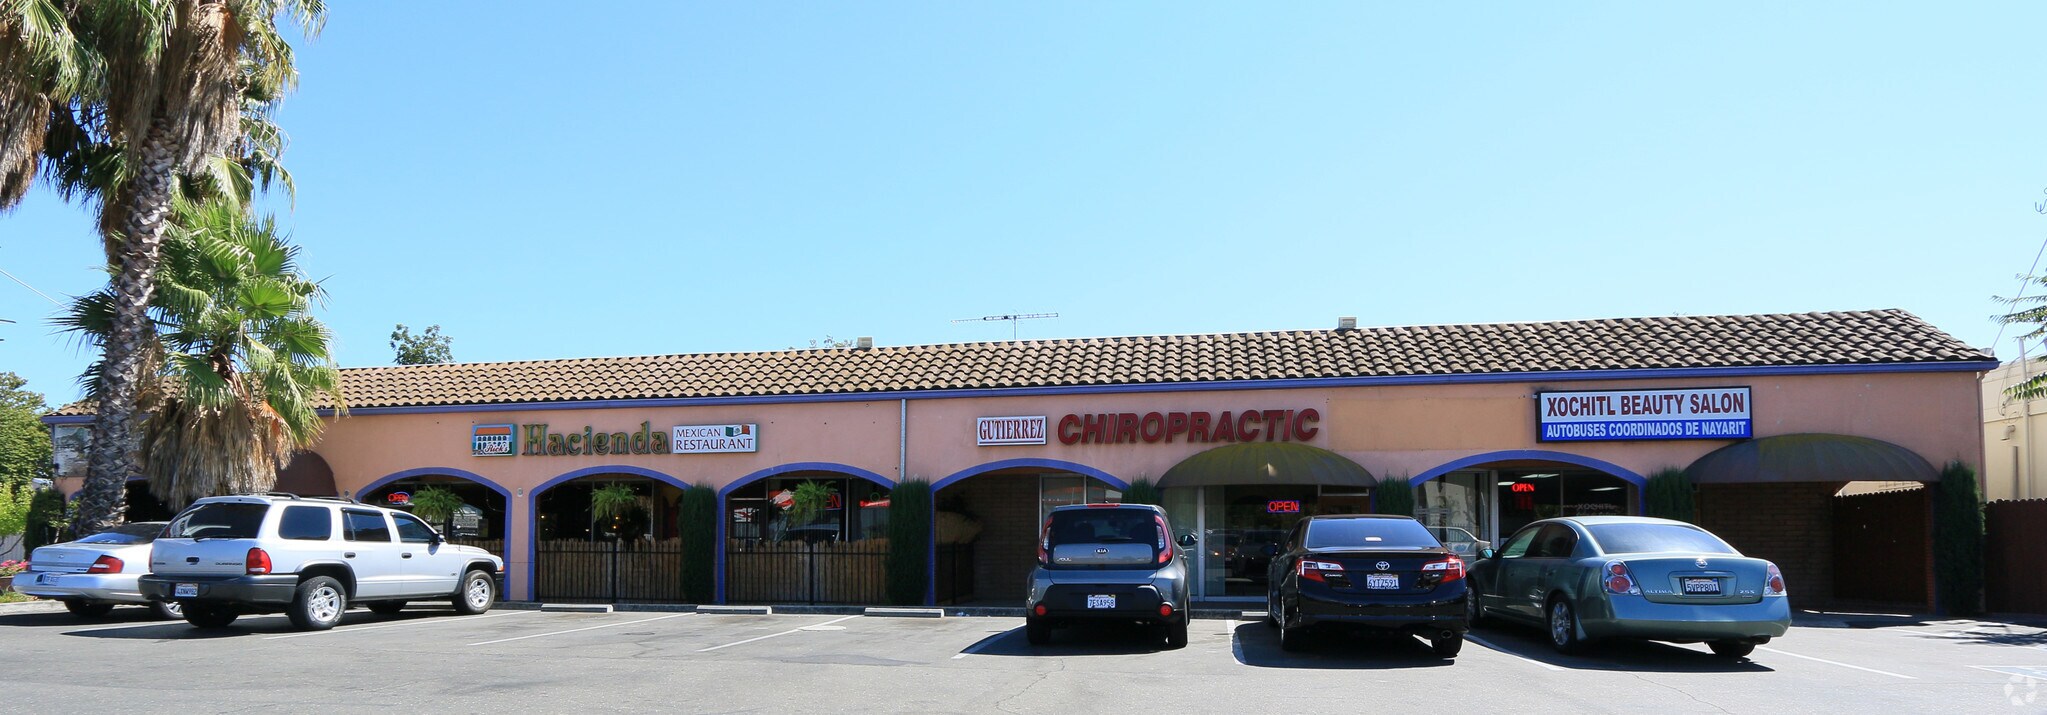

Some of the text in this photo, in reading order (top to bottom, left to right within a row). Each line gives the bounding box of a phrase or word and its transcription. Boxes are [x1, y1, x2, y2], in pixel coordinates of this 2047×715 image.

[1546, 393, 1744, 417] XOCHITL BEAUTY SALON
[676, 428, 721, 438] MEXICAN
[979, 418, 1044, 440] GUTIERREZ
[1057, 408, 1320, 446] CHIROPRACTIC
[1546, 421, 1746, 438] AUTOBUSES COORDINADOS DE NAYARIT
[522, 421, 671, 456] Hacienda
[676, 438, 753, 451] RESTAURANT
[1512, 483, 1535, 493] OPEN
[1269, 501, 1299, 512] OPEN
[1687, 583, 1719, 592] 5VPP801
